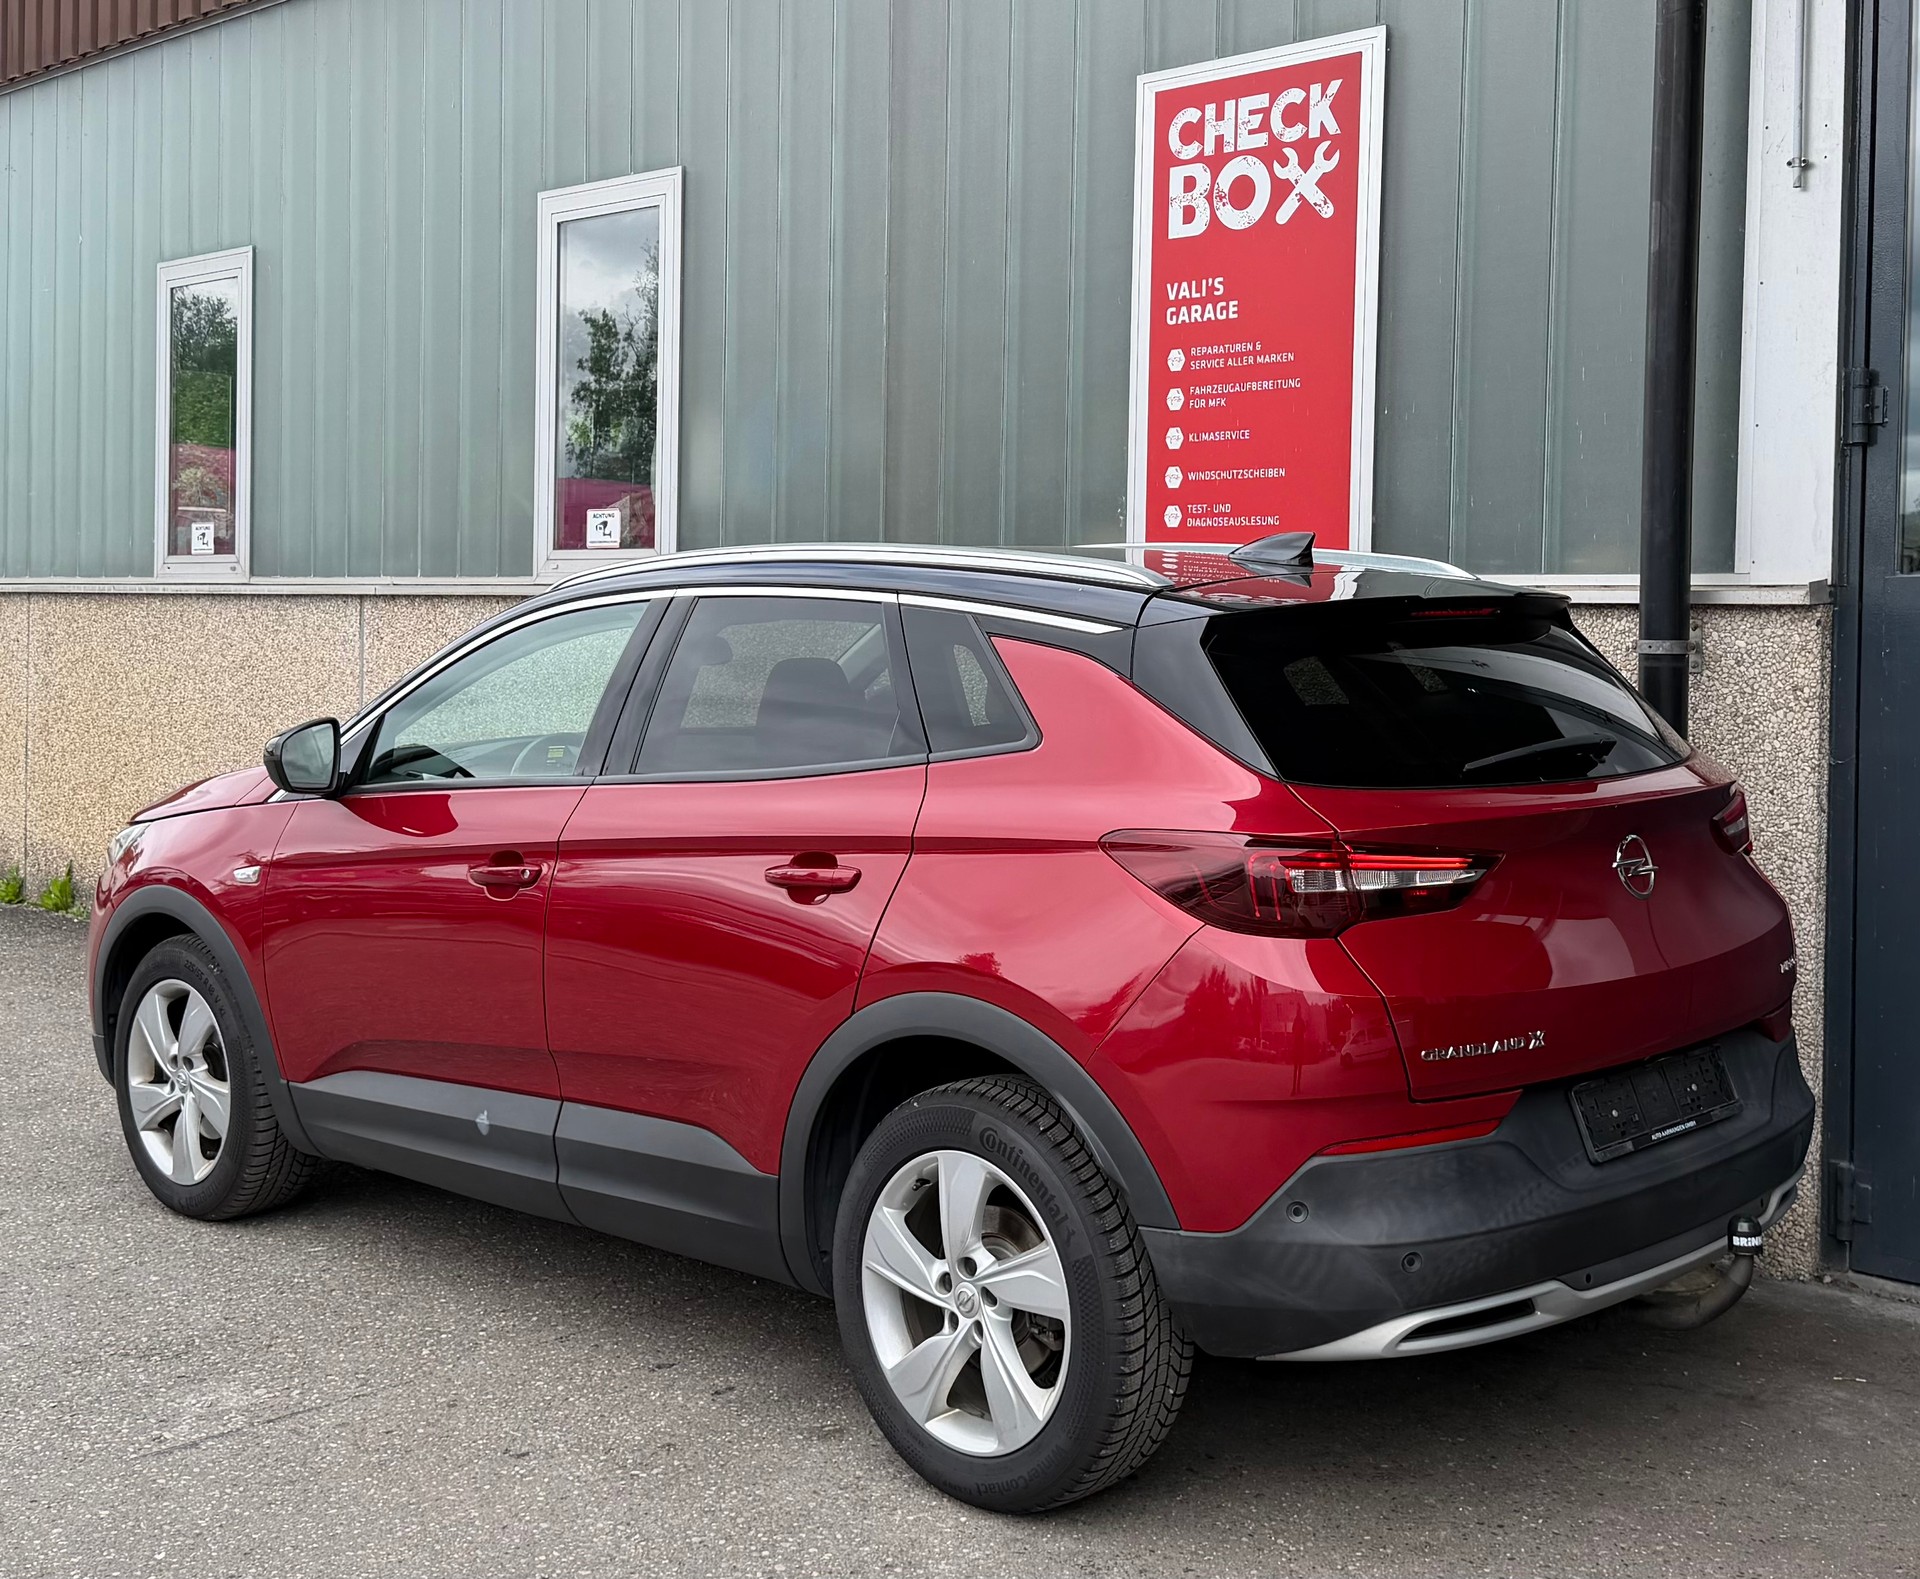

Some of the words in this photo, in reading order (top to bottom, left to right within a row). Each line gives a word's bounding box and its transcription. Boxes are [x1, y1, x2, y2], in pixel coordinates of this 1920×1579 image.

[1168, 78, 1343, 160] CHECK
[1166, 277, 1225, 301] VALI'S
[1166, 300, 1239, 326] GARAGE
[1190, 342, 1253, 357] REPARATUREN
[1255, 341, 1262, 351] &
[1190, 358, 1225, 370] SERVICE
[1227, 355, 1254, 367] ALLER
[1256, 352, 1295, 365] MARKEN
[1189, 377, 1301, 396] FAHRZEUGAUFBEREITUNG
[1189, 397, 1206, 409] FÜR
[1208, 397, 1227, 408] MFK
[1188, 429, 1251, 442] KLIMASERVICE
[1187, 467, 1286, 481] WINDSCHUTZSCHEIBEN
[1187, 504, 1211, 514] TEST-
[1213, 503, 1231, 513] UND
[1186, 515, 1280, 527] DIAGNOSEAUSLESUNG
[1421, 1037, 1526, 1061] GRANDLAND
[979, 1126, 1069, 1224] Continental
